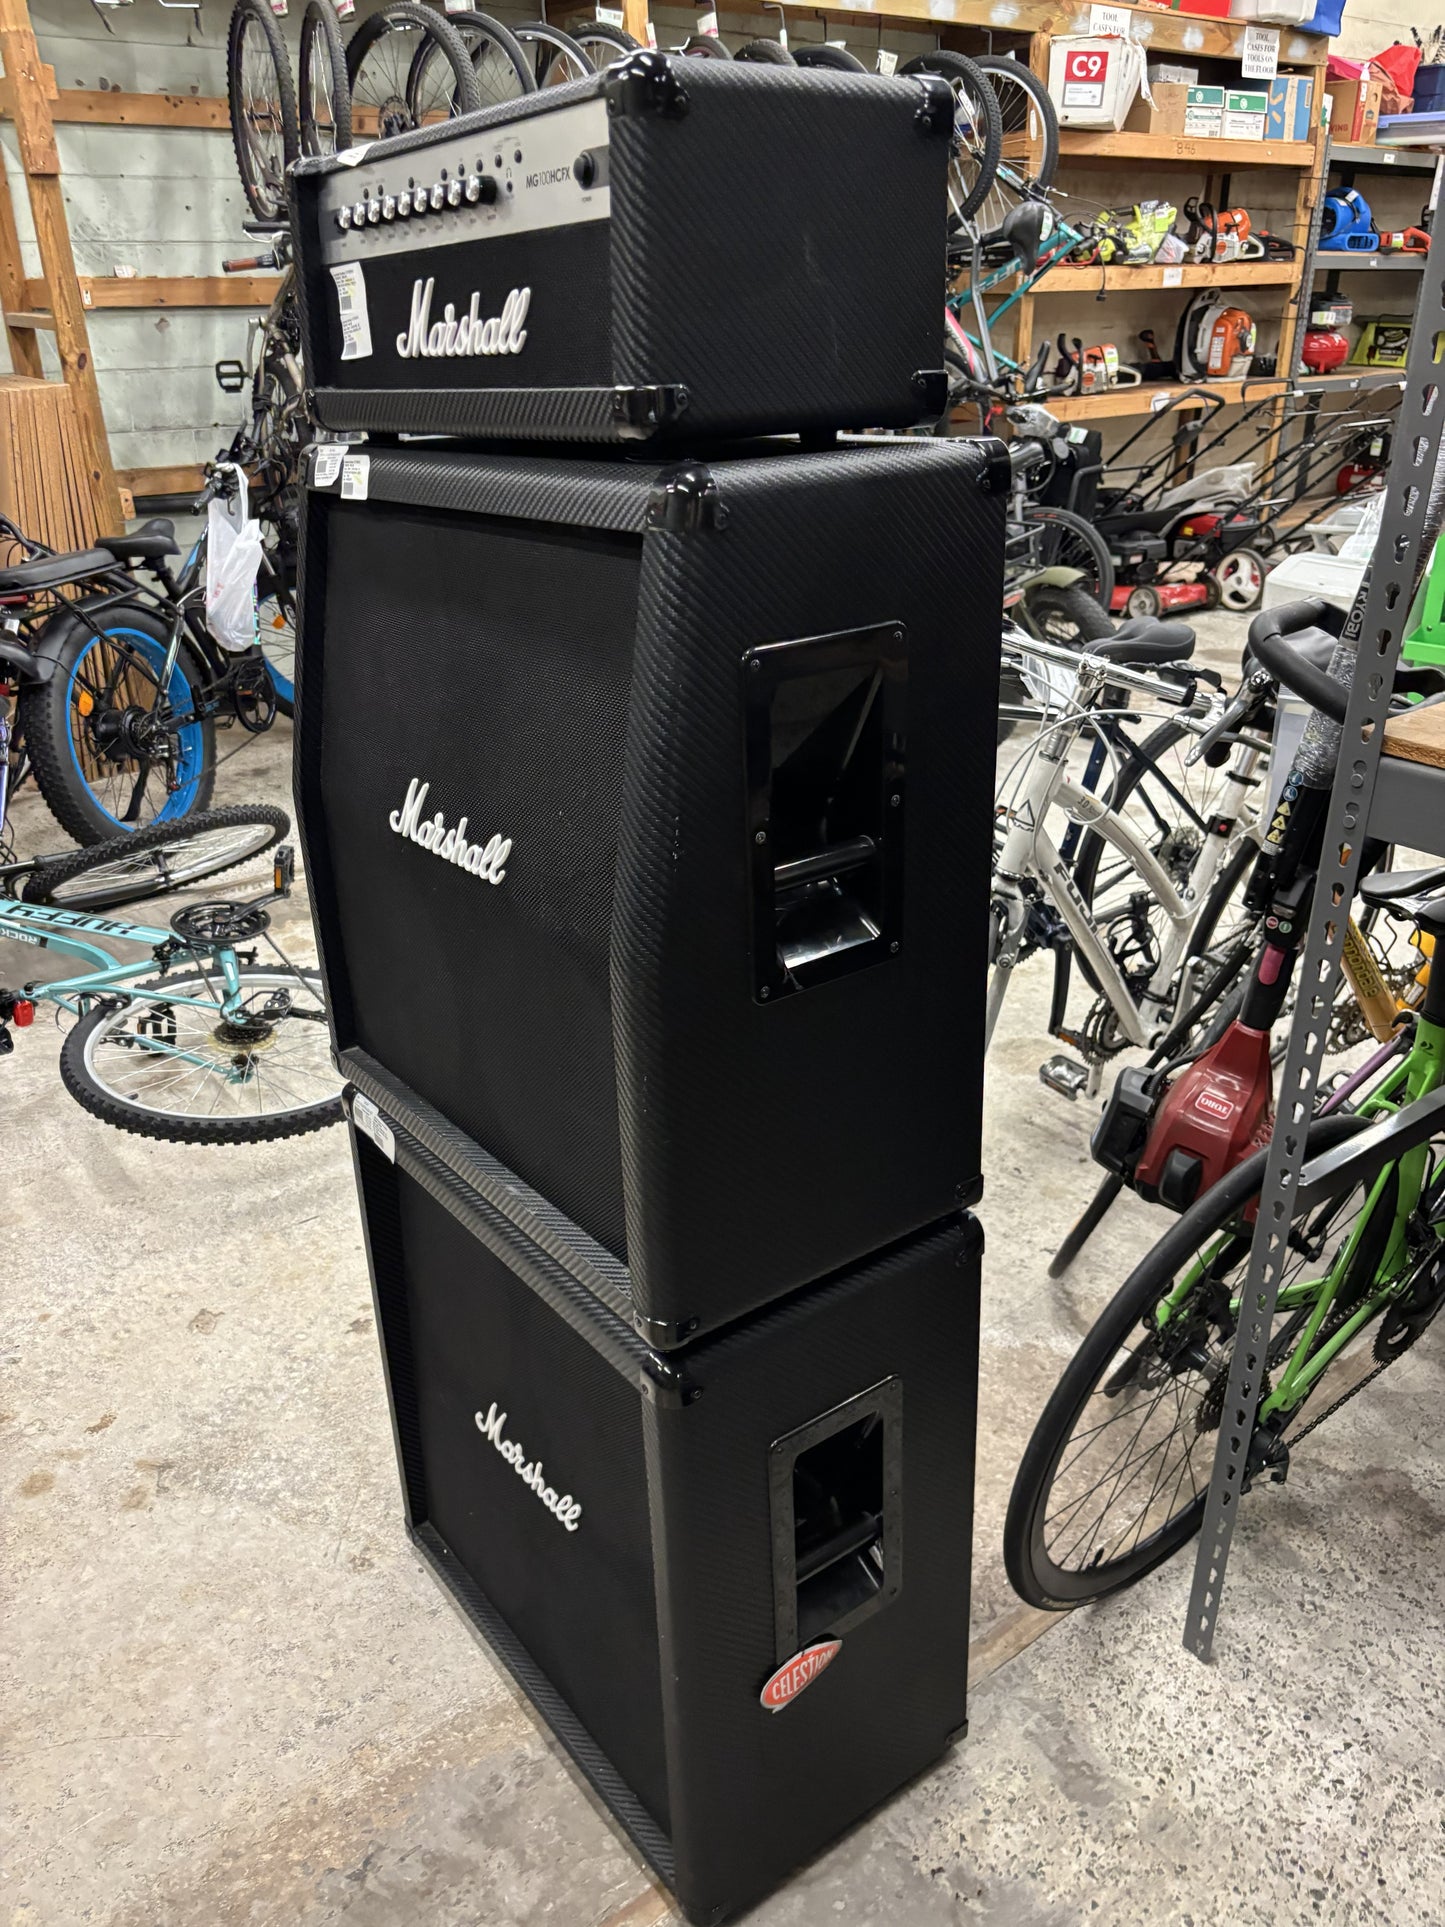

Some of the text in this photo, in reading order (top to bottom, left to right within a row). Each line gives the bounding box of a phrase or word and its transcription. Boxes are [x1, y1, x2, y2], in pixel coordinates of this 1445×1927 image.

[1093, 22, 1112, 33] CASES
[1102, 12, 1118, 22] TOOL
[1247, 42, 1276, 53] CASES FOR
[1255, 32, 1269, 42] TOOL
[1072, 55, 1102, 78] C9
[1245, 64, 1274, 74] THE FLOOR
[1247, 53, 1273, 63] TOOLS ON
[526, 166, 571, 189] MG100HCFX
[396, 276, 531, 358] Marshall
[1345, 590, 1368, 638] RYOBI
[389, 777, 512, 886] Marshall
[1053, 862, 1098, 935] FUJI
[6, 904, 140, 935] HUFFY
[1200, 1097, 1229, 1114] TORO
[474, 1402, 582, 1531] Marshall
[772, 1648, 834, 1700] CELESTION
